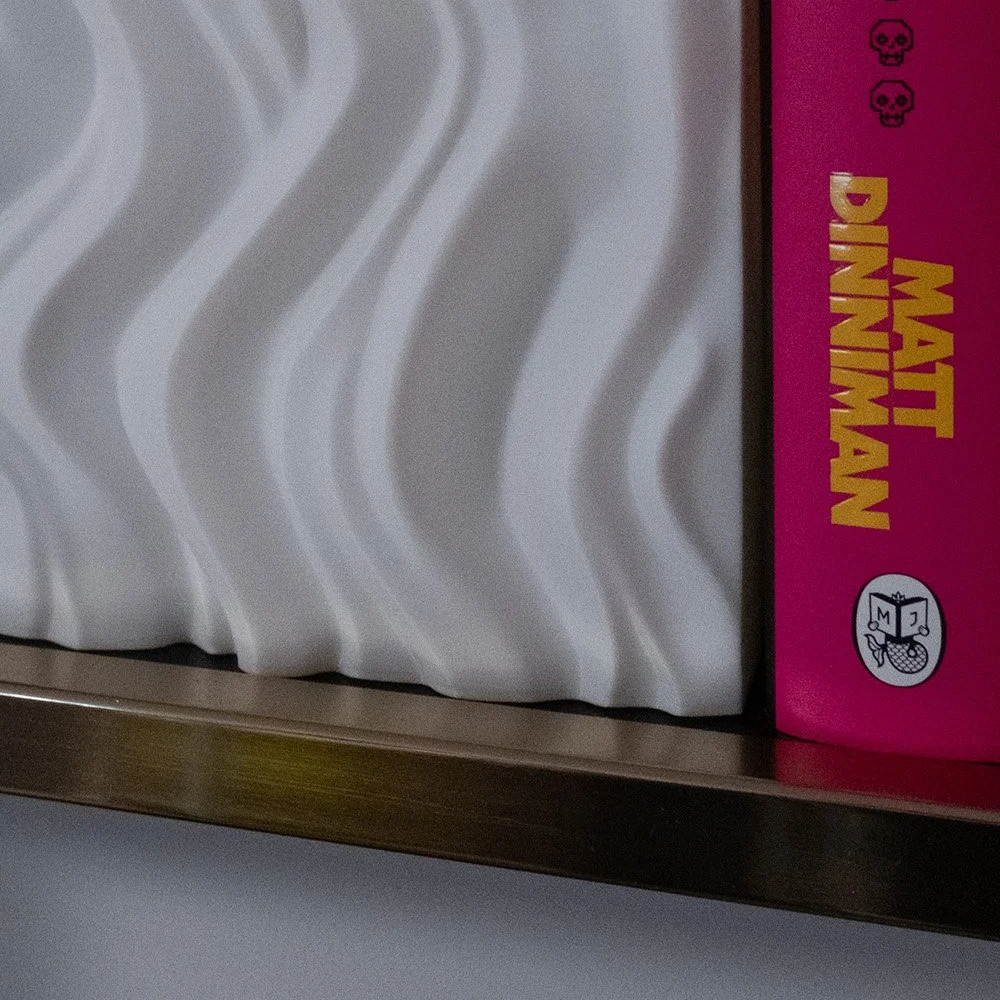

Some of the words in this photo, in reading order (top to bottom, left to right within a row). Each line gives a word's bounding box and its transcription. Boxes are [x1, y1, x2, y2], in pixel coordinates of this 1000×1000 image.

[829, 172, 891, 531] DINNIMAN
[893, 258, 954, 439] MATT
[877, 606, 890, 625] M
[909, 611, 918, 627] J
